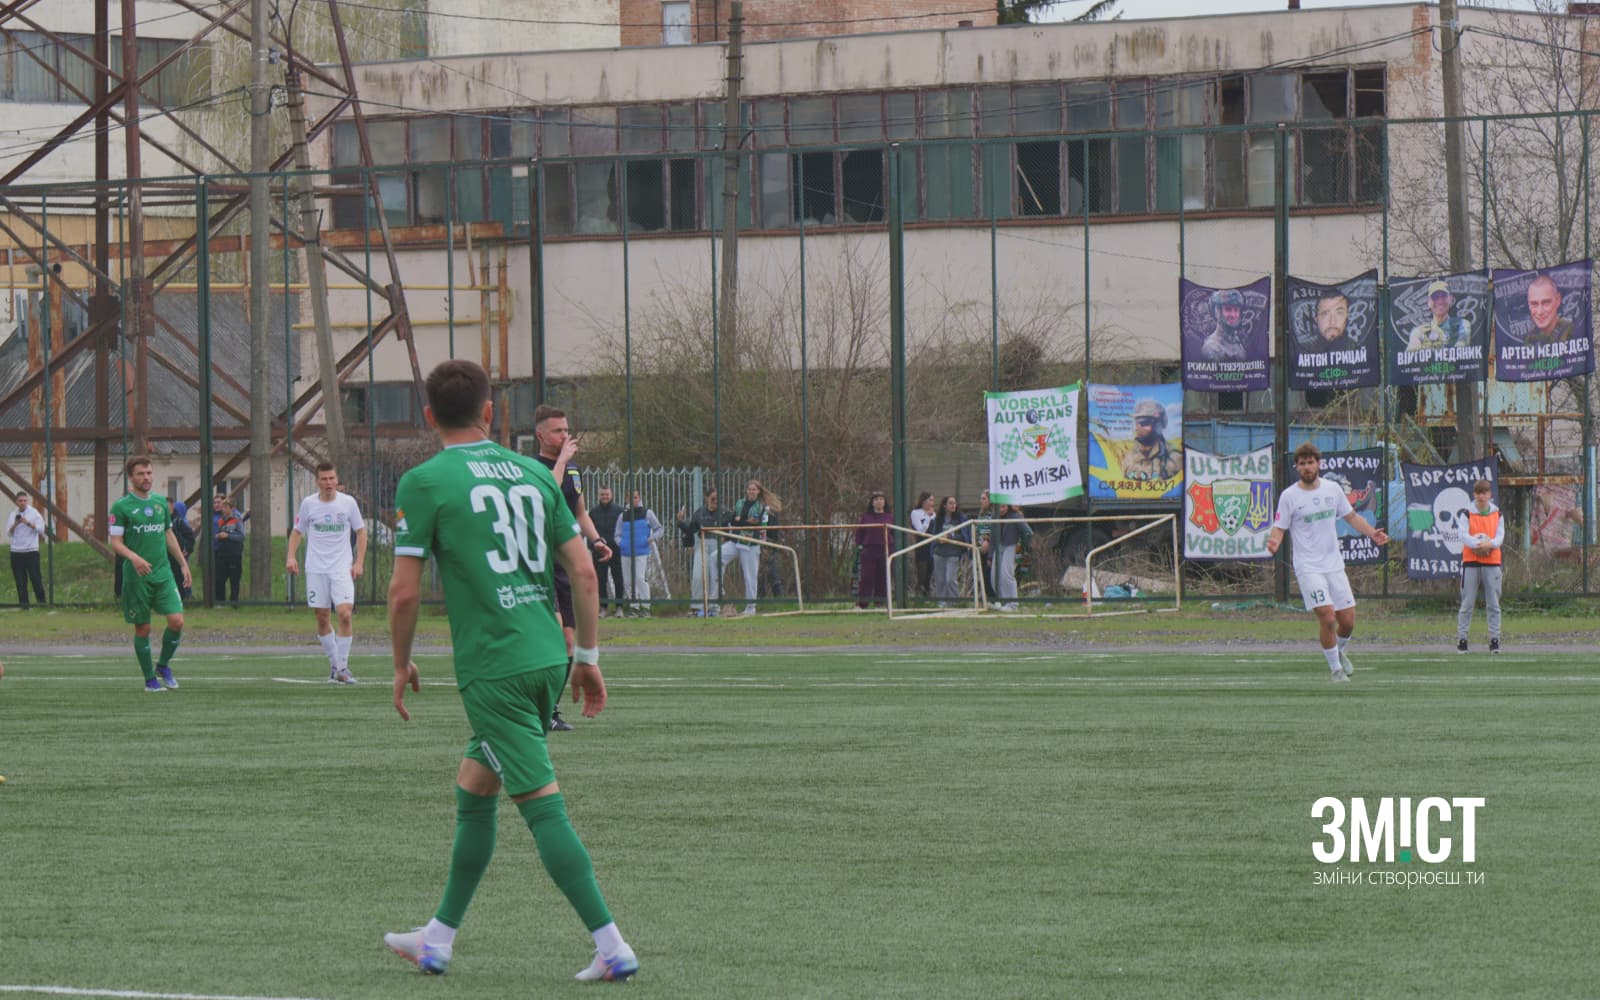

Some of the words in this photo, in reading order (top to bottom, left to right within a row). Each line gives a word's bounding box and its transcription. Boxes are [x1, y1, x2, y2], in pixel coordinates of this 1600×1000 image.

[1298, 352, 1328, 367] АНТОН
[1330, 346, 1366, 365] ГРИЦАЙ
[1434, 346, 1482, 362] МЕДЯНИК
[1502, 346, 1534, 360] АРТЕМ
[1187, 362, 1217, 371] РОМАН
[998, 394, 1069, 410] VORSKLA
[994, 405, 1072, 424] AUTOFANS
[1190, 455, 1270, 476] ULTRAS
[1000, 474, 1020, 490] НА
[470, 484, 547, 574] 30
[1350, 536, 1373, 549] РАЙ
[309, 591, 316, 603] 2
[1311, 590, 1325, 604] 43
